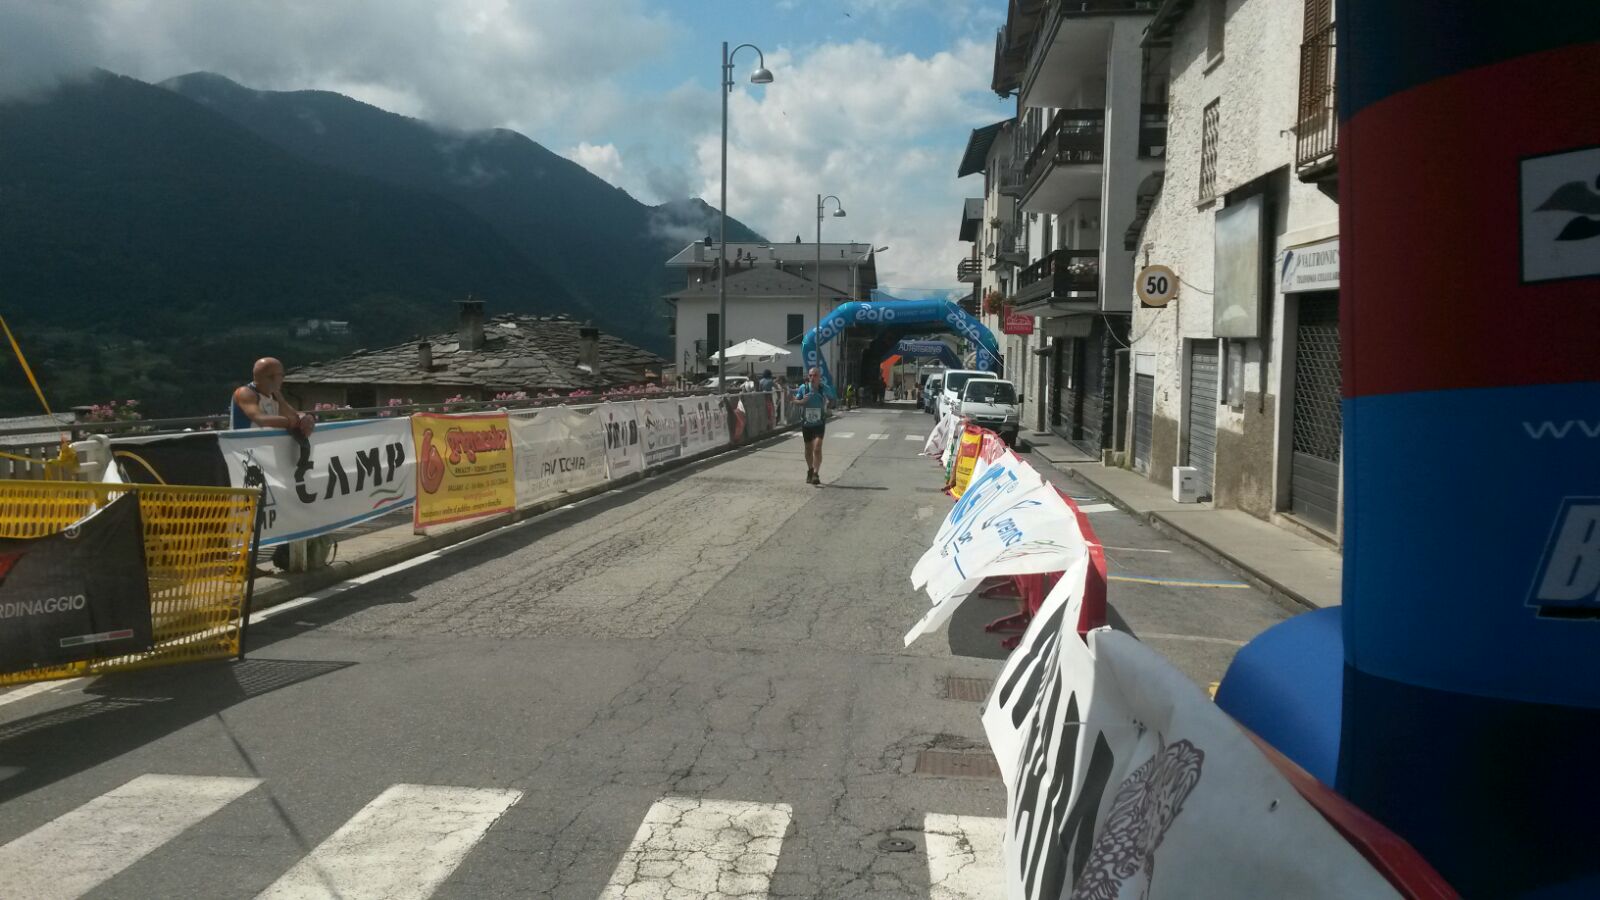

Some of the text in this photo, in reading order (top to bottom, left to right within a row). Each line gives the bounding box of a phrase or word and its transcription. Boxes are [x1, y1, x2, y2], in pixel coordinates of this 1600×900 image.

[1146, 276, 1168, 295] 50
[855, 305, 896, 322] eolo
[946, 311, 981, 341] eolo
[293, 441, 405, 505] CAMP
